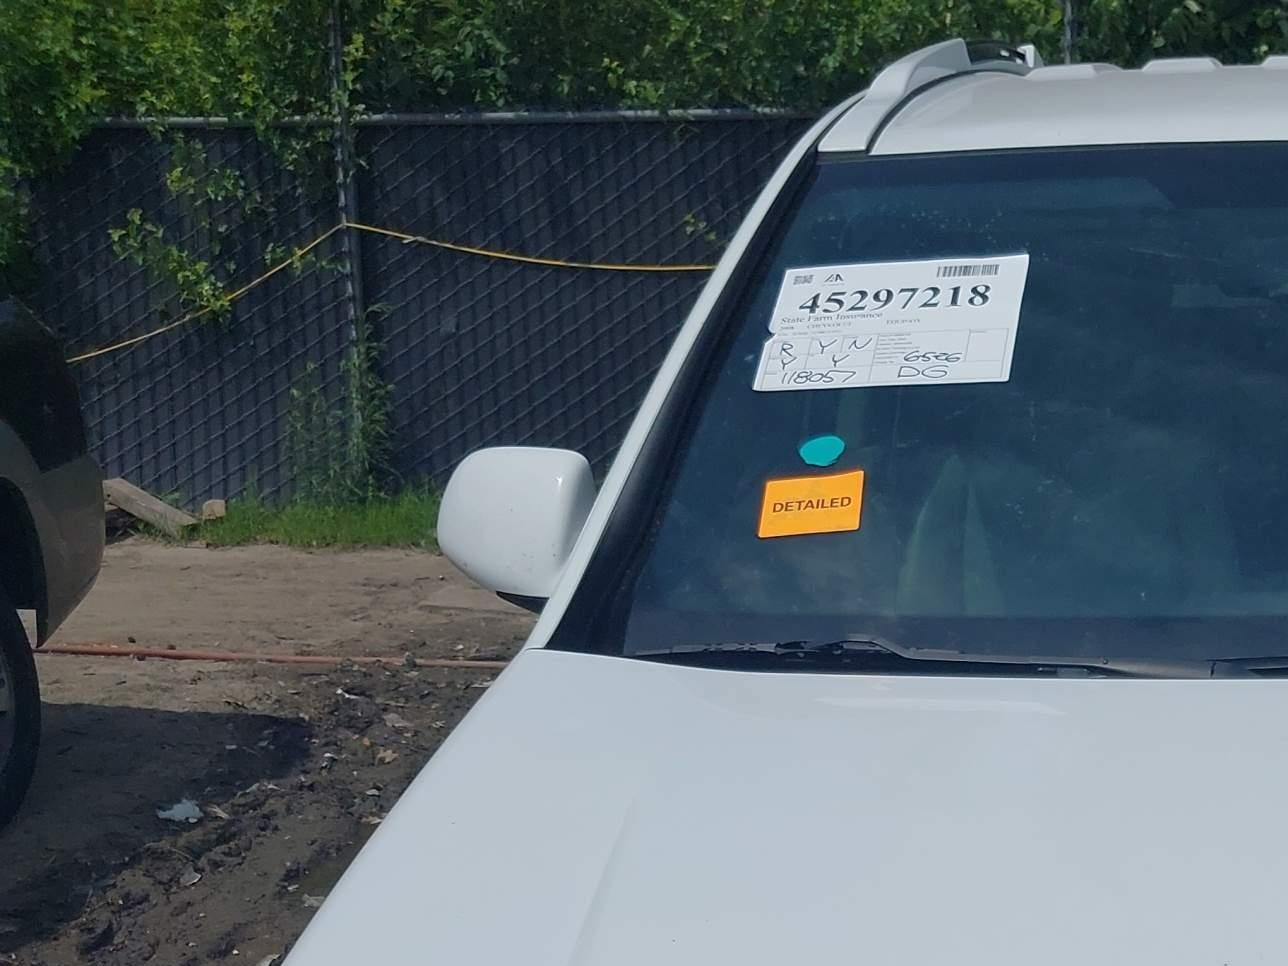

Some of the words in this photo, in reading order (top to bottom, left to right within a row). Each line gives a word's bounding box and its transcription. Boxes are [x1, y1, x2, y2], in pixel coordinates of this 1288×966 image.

[798, 284, 992, 315] 45297218
[781, 316, 806, 325] State
[807, 315, 833, 323] Farm
[780, 343, 794, 357] R
[772, 496, 852, 513] DETAILED
